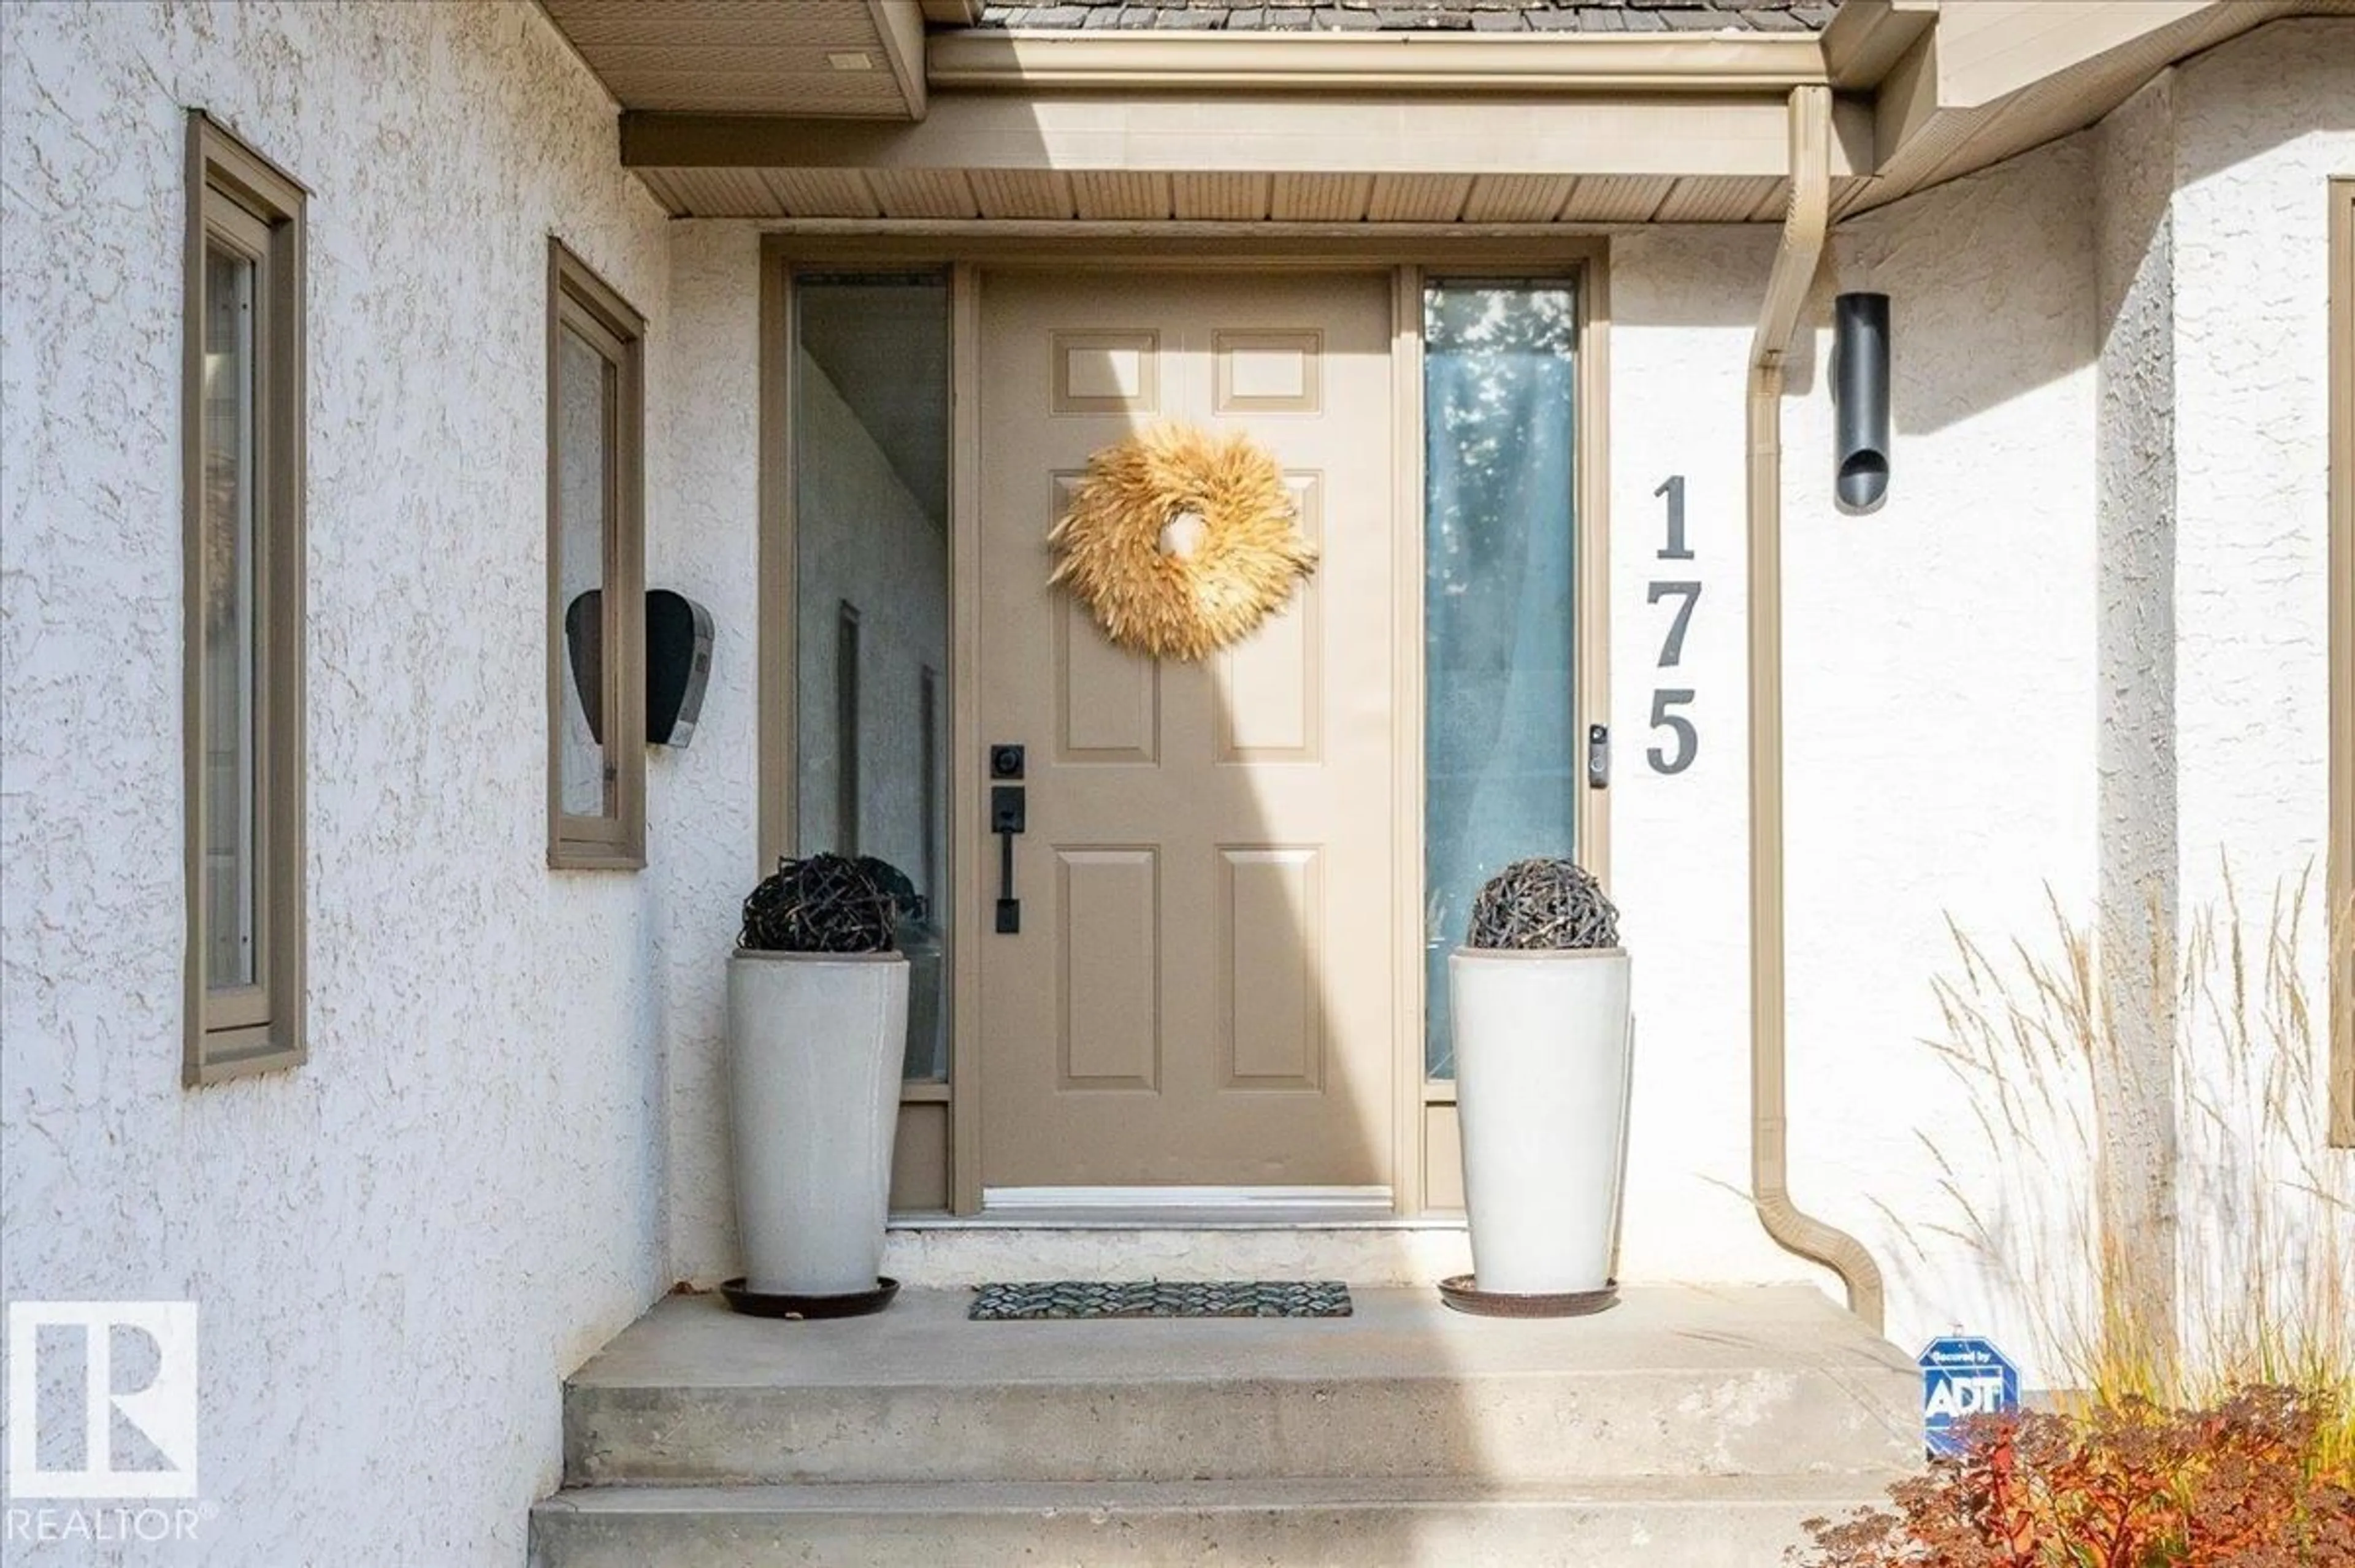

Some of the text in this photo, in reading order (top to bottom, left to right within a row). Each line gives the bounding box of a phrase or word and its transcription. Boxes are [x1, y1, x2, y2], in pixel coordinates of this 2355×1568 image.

[1646, 475, 1702, 775] 175
[1977, 1351, 1991, 1363] by
[1924, 1377, 2001, 1418] ADT
